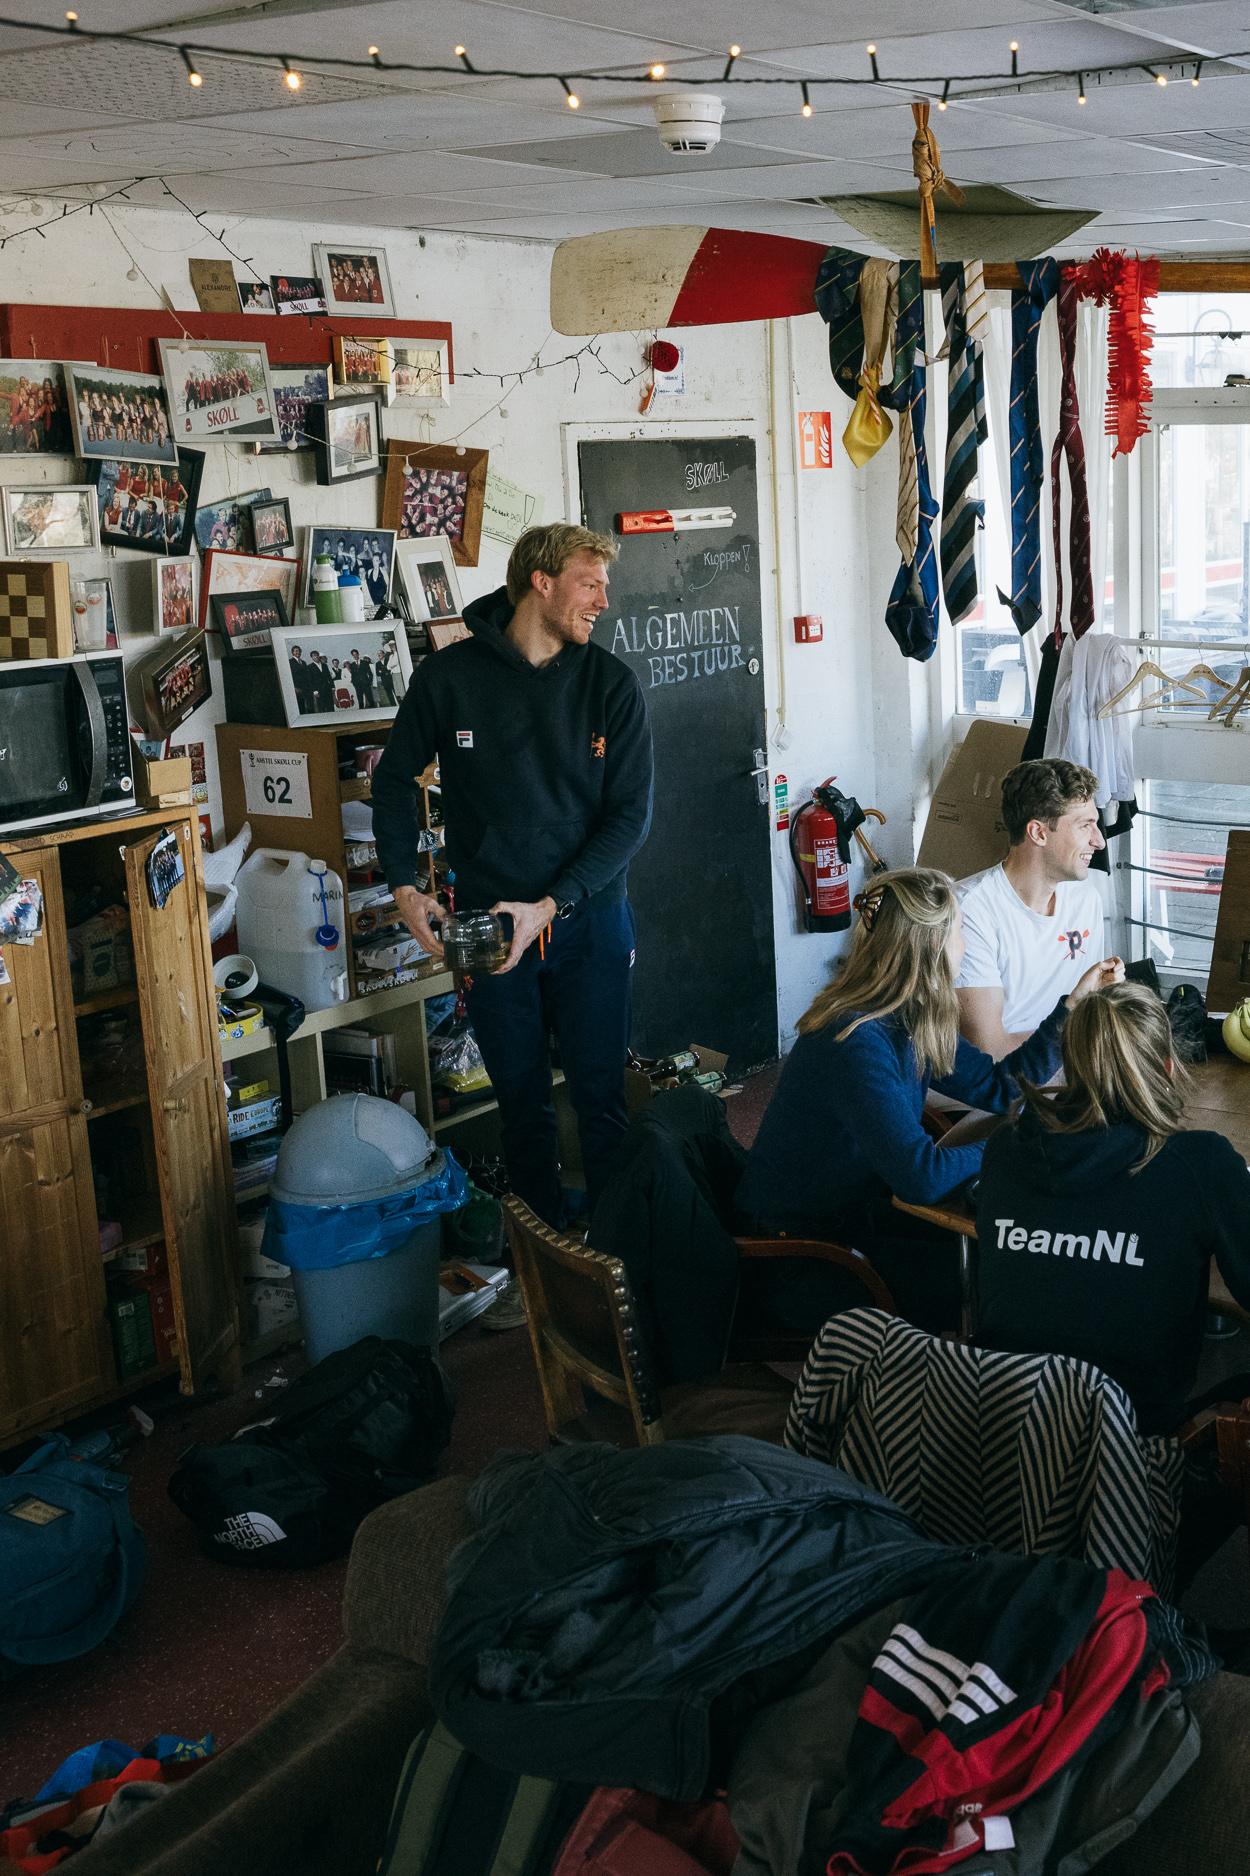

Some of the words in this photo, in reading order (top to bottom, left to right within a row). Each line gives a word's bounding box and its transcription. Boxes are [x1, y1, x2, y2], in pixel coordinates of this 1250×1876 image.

[201, 284, 232, 292] ALEXANDRE
[206, 406, 240, 428] SKØLL
[685, 461, 729, 490] SKØLL
[242, 633, 267, 647] SKØLL
[610, 606, 741, 655] ALGEMEEN
[647, 644, 746, 689] BESTUUR
[263, 775, 293, 804] 62
[232, 1111, 250, 1124] RIDE
[994, 1218, 1145, 1267] TeamNL
[223, 1512, 250, 1530] THE
[213, 1524, 257, 1544] NORTH
[230, 1535, 264, 1551] FACE
